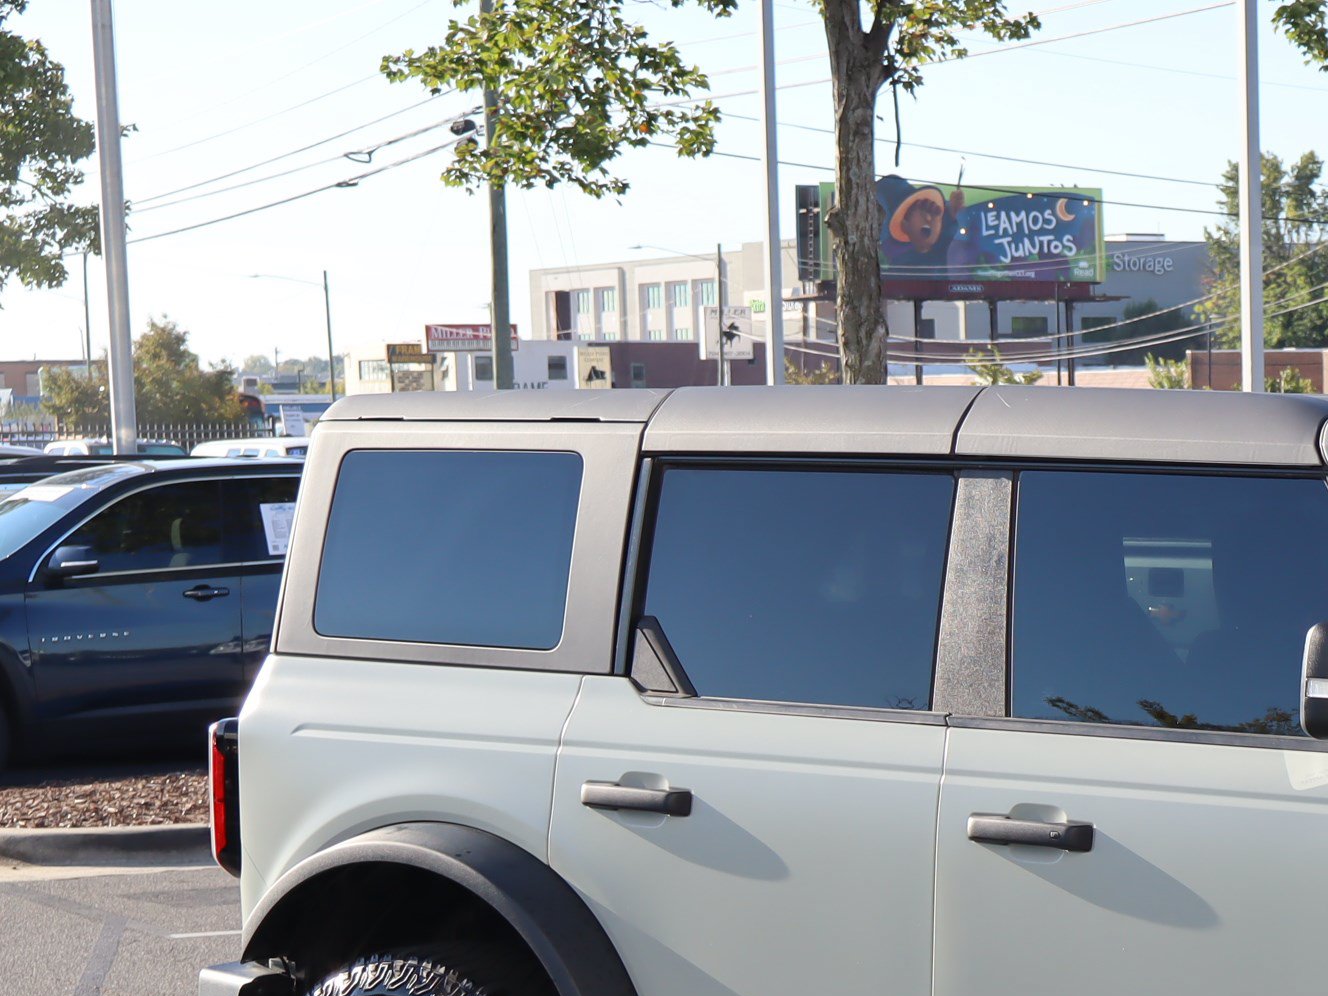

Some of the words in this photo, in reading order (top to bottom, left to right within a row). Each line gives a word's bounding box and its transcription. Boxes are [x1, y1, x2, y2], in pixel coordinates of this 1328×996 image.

[981, 210, 1057, 237] LEAMOS
[994, 234, 1078, 264] JUNTOS
[1113, 253, 1174, 275] Storage
